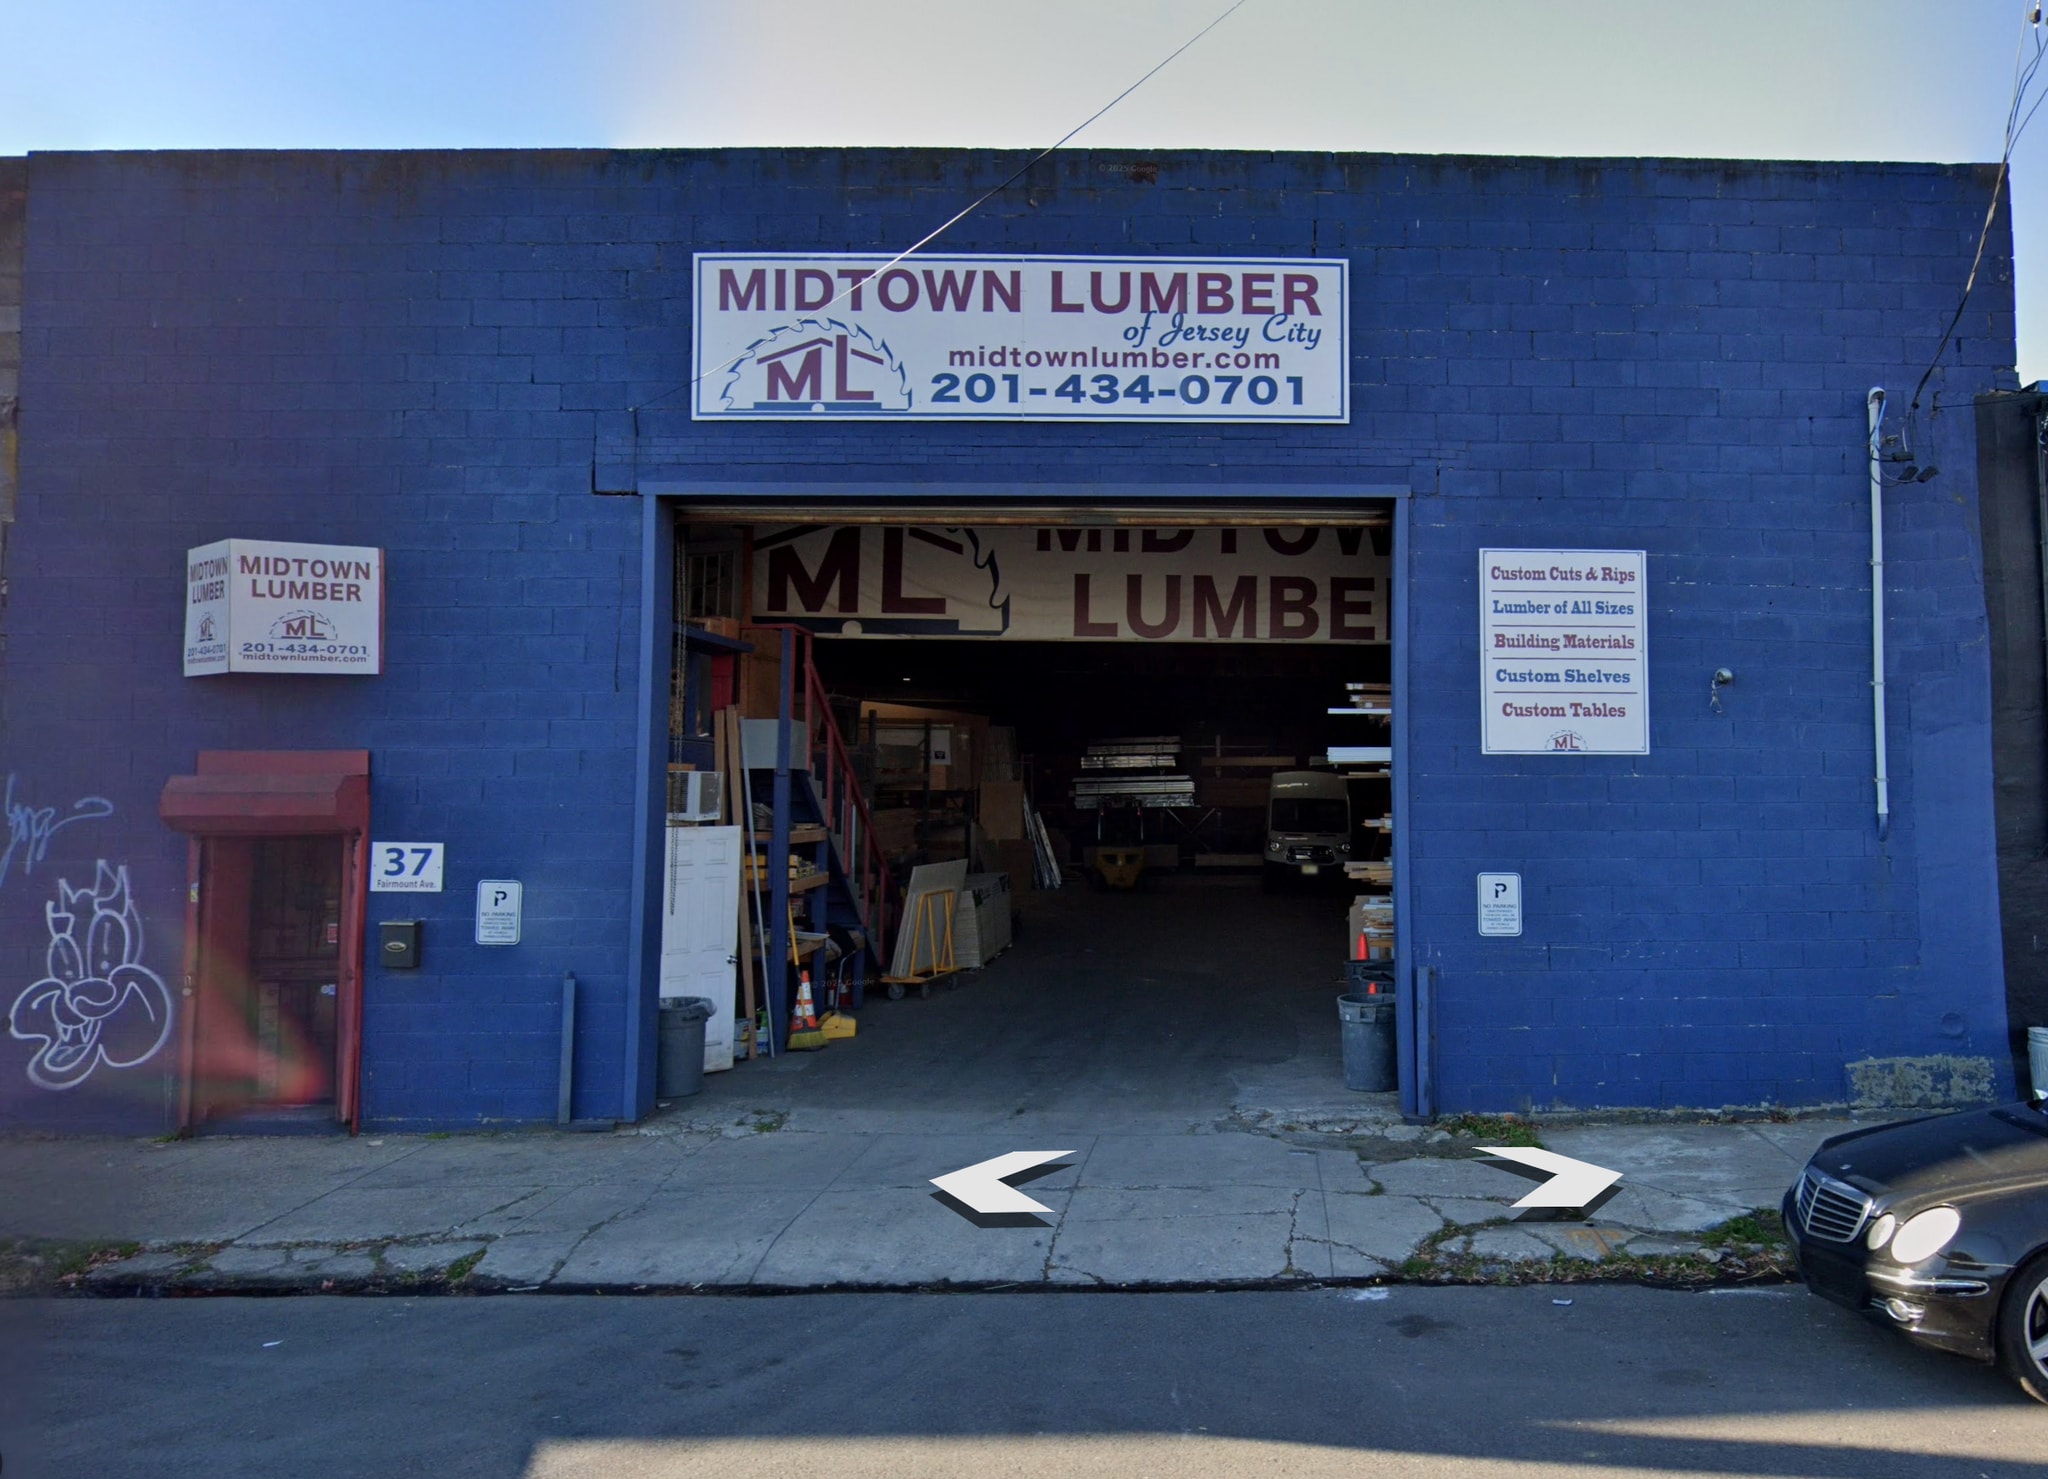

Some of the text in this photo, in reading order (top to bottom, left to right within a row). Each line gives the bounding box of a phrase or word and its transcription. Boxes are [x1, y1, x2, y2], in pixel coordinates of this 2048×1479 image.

[719, 268, 1322, 316] MIDTOWN LUMBER
[1123, 310, 1322, 350] of Jersey City
[767, 334, 874, 401] ML
[949, 345, 1280, 369] midtownlumber.com
[930, 372, 1304, 405] 201-434-0701
[190, 557, 228, 583] MIDTOWN
[240, 555, 370, 580] MIDTOWN
[1491, 565, 1635, 584] Custom Cuts & Rips
[192, 580, 225, 604] LUMBER
[251, 578, 362, 602] LUMBER
[1073, 572, 1391, 641] LUMBE
[1492, 599, 1634, 615] Lumber of All Sizes
[285, 614, 325, 637] ML
[242, 642, 367, 655] 201-434-0701
[1494, 633, 1635, 651] Building Materials
[242, 653, 367, 663] midtownlumber.com
[1495, 669, 1631, 684] Custom Shelves
[1502, 702, 1626, 717] Custom Tables
[1554, 733, 1579, 749] ML
[384, 847, 433, 877] 37
[377, 880, 437, 889] Fairmount Ave.
